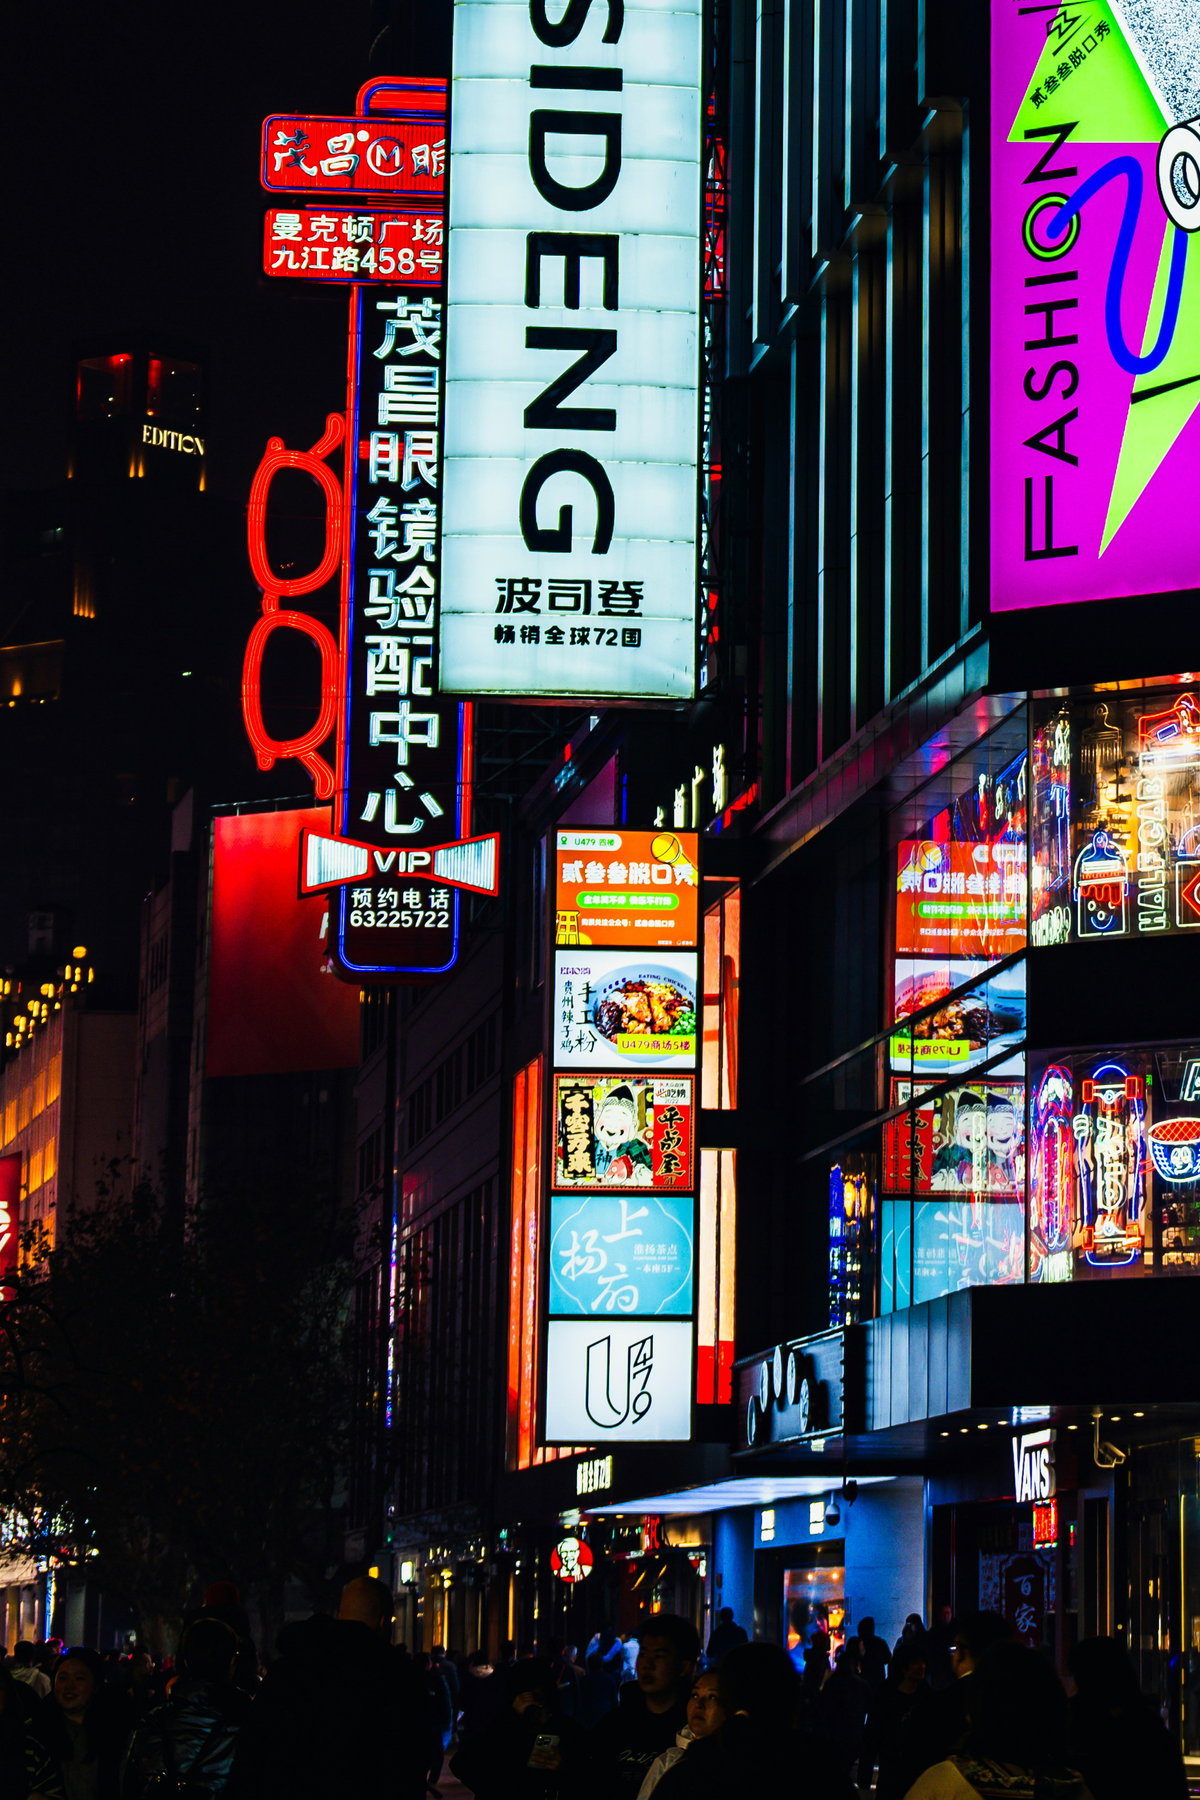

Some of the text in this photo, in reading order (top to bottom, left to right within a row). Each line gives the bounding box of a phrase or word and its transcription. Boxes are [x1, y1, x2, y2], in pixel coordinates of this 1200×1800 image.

[1029, 19, 1112, 109] 贰叁叁脱口秀
[273, 128, 360, 177] 茂昌
[271, 213, 444, 246] 曼克顿广场
[271, 245, 443, 276] 九江路458号
[1021, 121, 1080, 562] FASHION
[142, 424, 205, 456] EDITION
[361, 296, 445, 834] 茂昌眼镜验配中心
[494, 577, 644, 617] 波司登
[493, 624, 642, 648] 畅销全球72国
[373, 847, 432, 874] VIP
[350, 887, 450, 909] 预约电话
[349, 909, 450, 929] 63225722
[574, 980, 598, 1053] 手工粉
[621, 1040, 691, 1051] U479商场5楼
[1012, 1429, 1052, 1503] VANS
